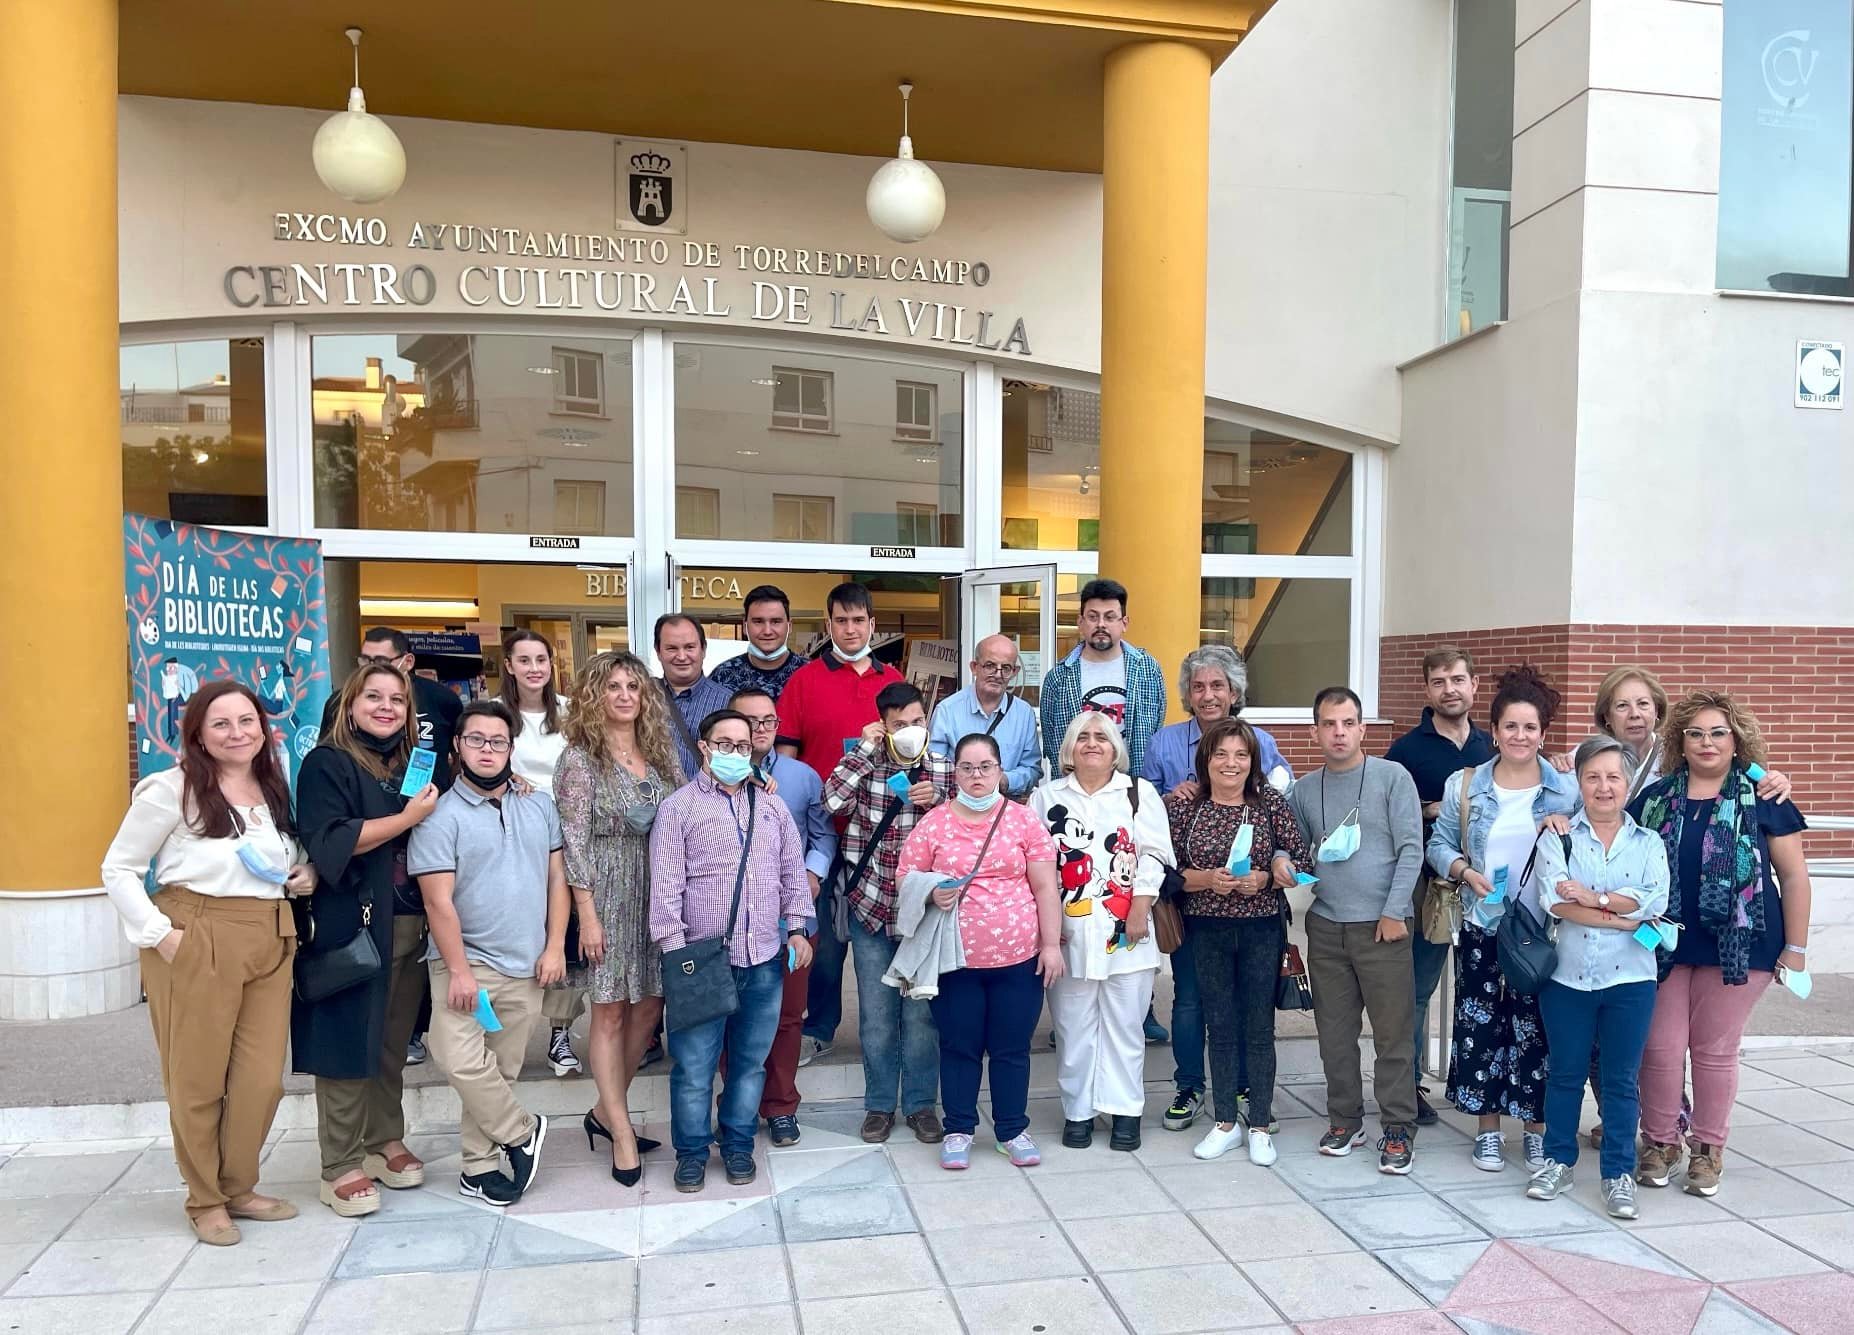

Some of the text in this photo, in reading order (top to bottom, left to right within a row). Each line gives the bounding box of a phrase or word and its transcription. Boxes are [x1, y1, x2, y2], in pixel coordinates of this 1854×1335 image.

[274, 213, 990, 287] EXCMO. AYUNTAMIENTO DE TORREDELCAMPO
[223, 263, 1032, 355] CENTRO CULTURAL DE LA VILLA
[532, 538, 576, 548] ENTRADA
[873, 548, 913, 558] ENTRADA
[163, 554, 258, 600] DÍA DE LAS
[164, 597, 284, 639] BIBLIOTECAS
